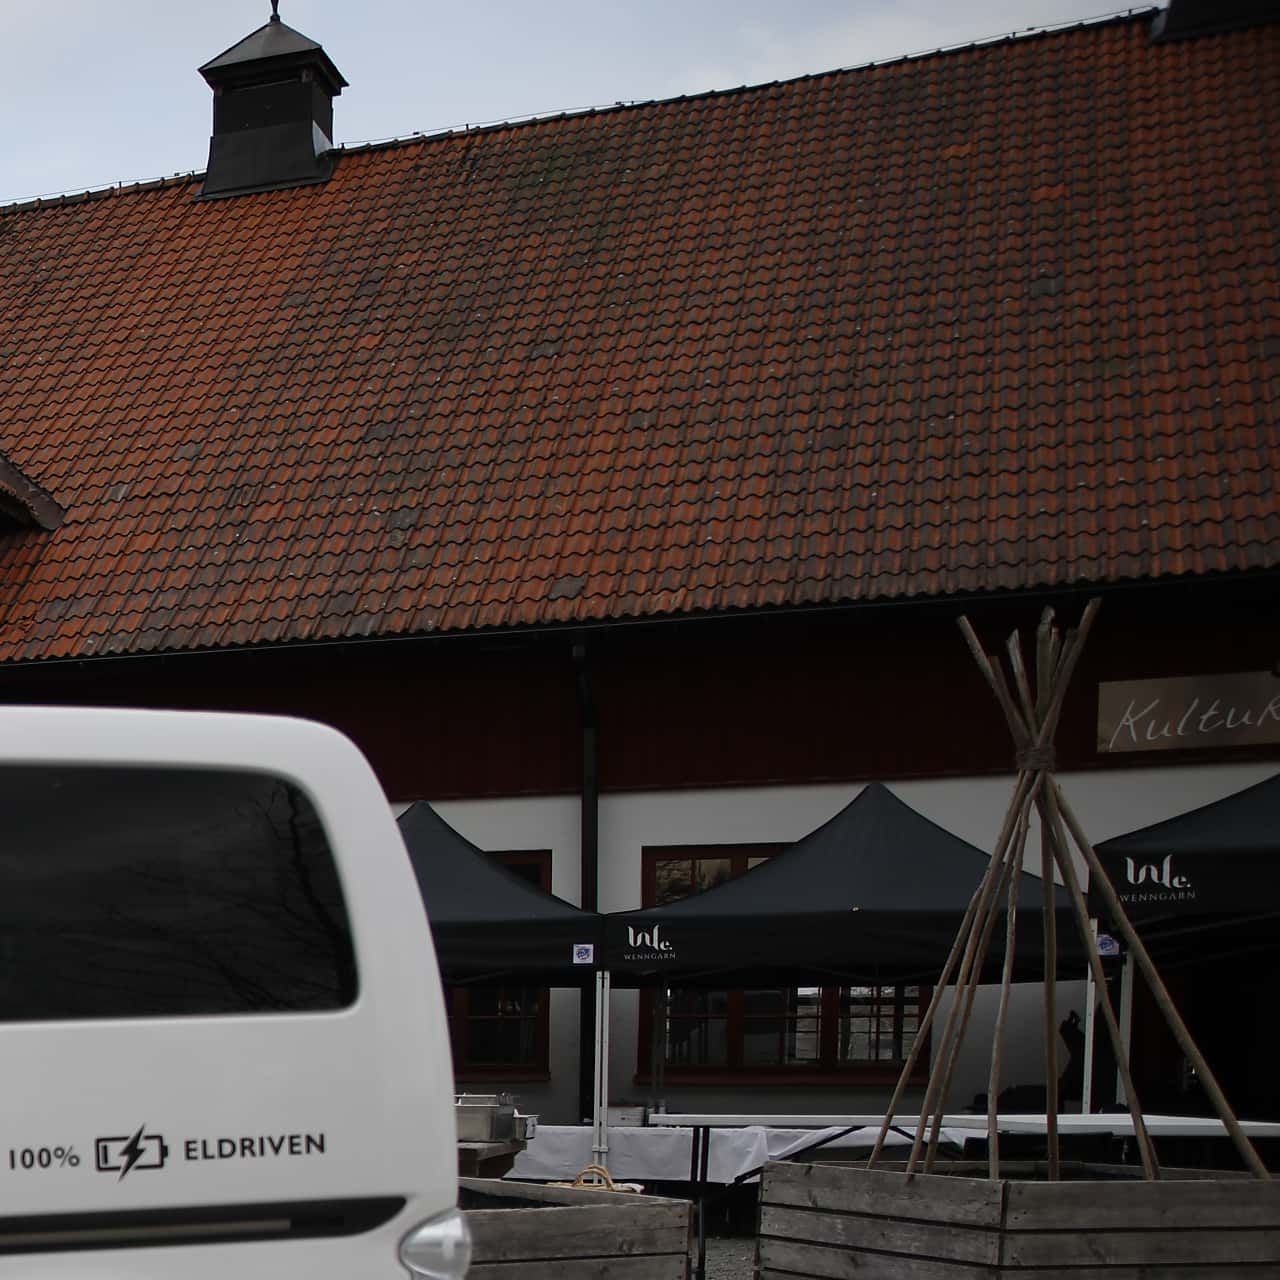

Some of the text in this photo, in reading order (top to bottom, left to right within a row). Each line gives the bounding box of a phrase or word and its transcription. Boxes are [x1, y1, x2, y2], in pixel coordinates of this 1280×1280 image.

[1119, 890, 1196, 903] WENNGARN
[623, 952, 676, 961] WENNGARN
[8, 1133, 326, 1171] 100% ELDRIVEN
